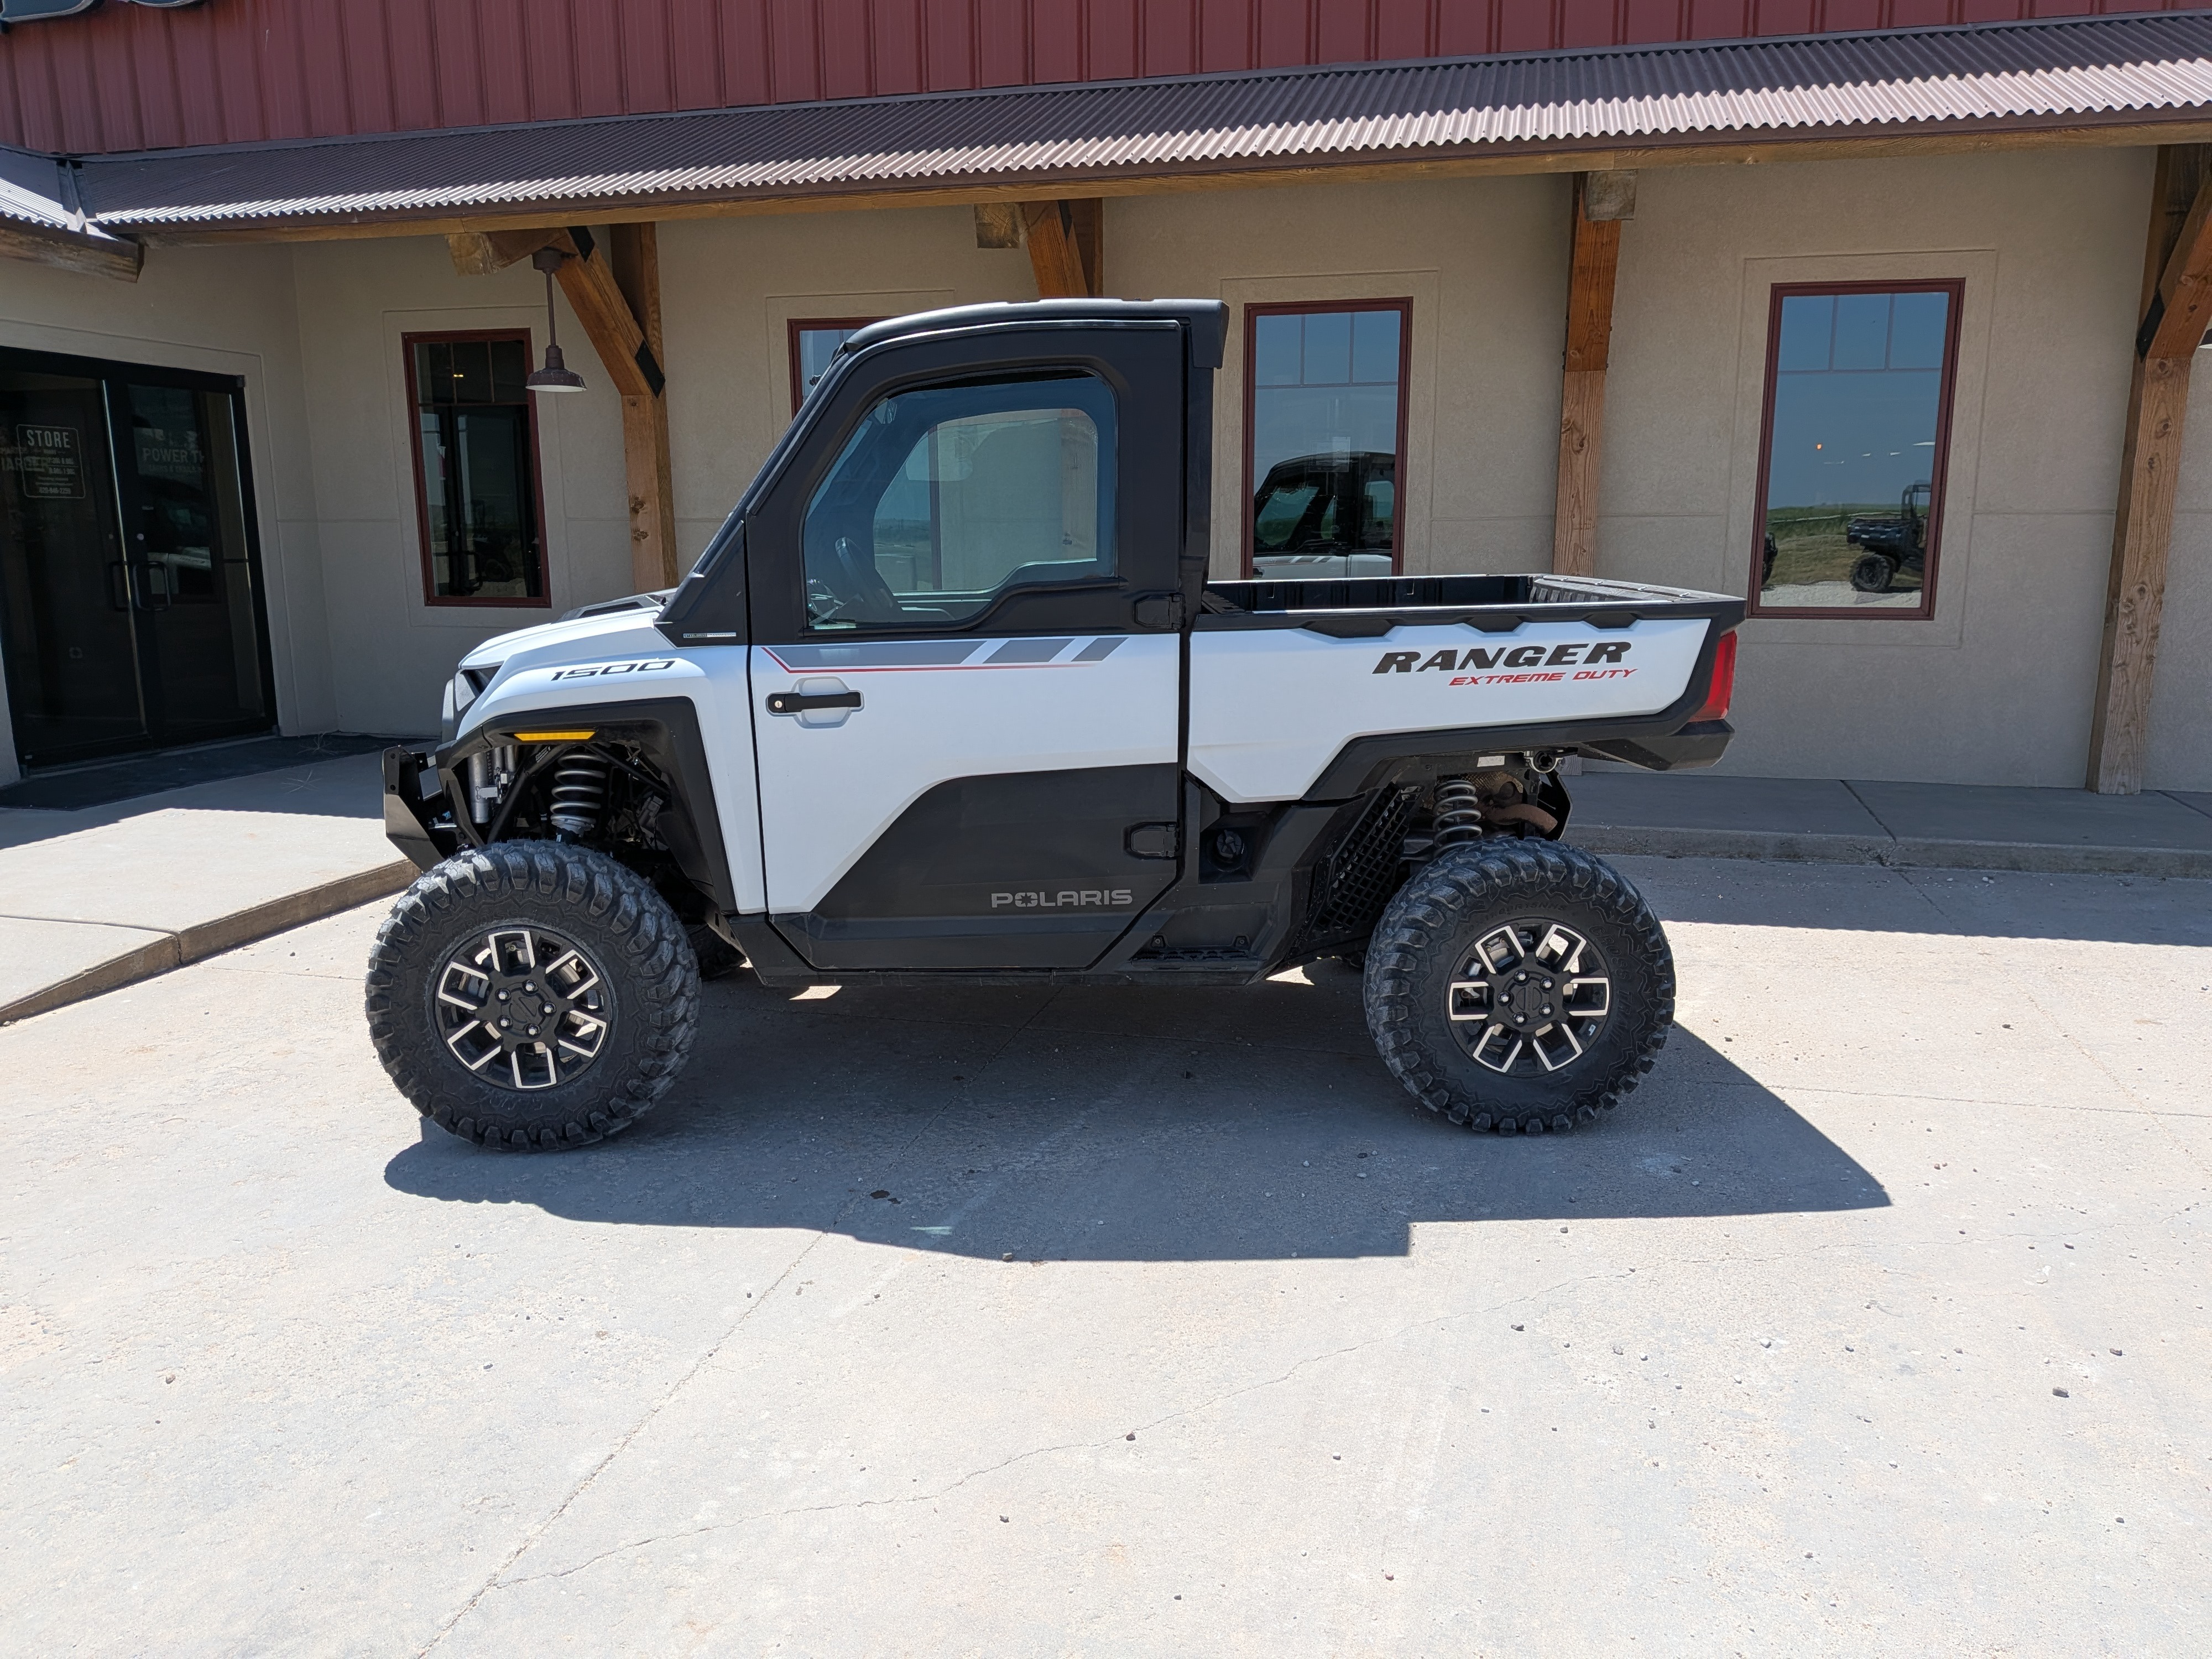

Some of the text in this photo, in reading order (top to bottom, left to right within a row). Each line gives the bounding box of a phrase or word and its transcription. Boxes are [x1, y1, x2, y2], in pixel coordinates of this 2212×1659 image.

[27, 429, 71, 448] STORE
[142, 448, 188, 463] POWER
[1371, 641, 1632, 674] RANGER
[551, 660, 676, 681] 1500
[1448, 668, 1639, 686] EXTREME DUTY
[991, 889, 1133, 908] POLARIS
